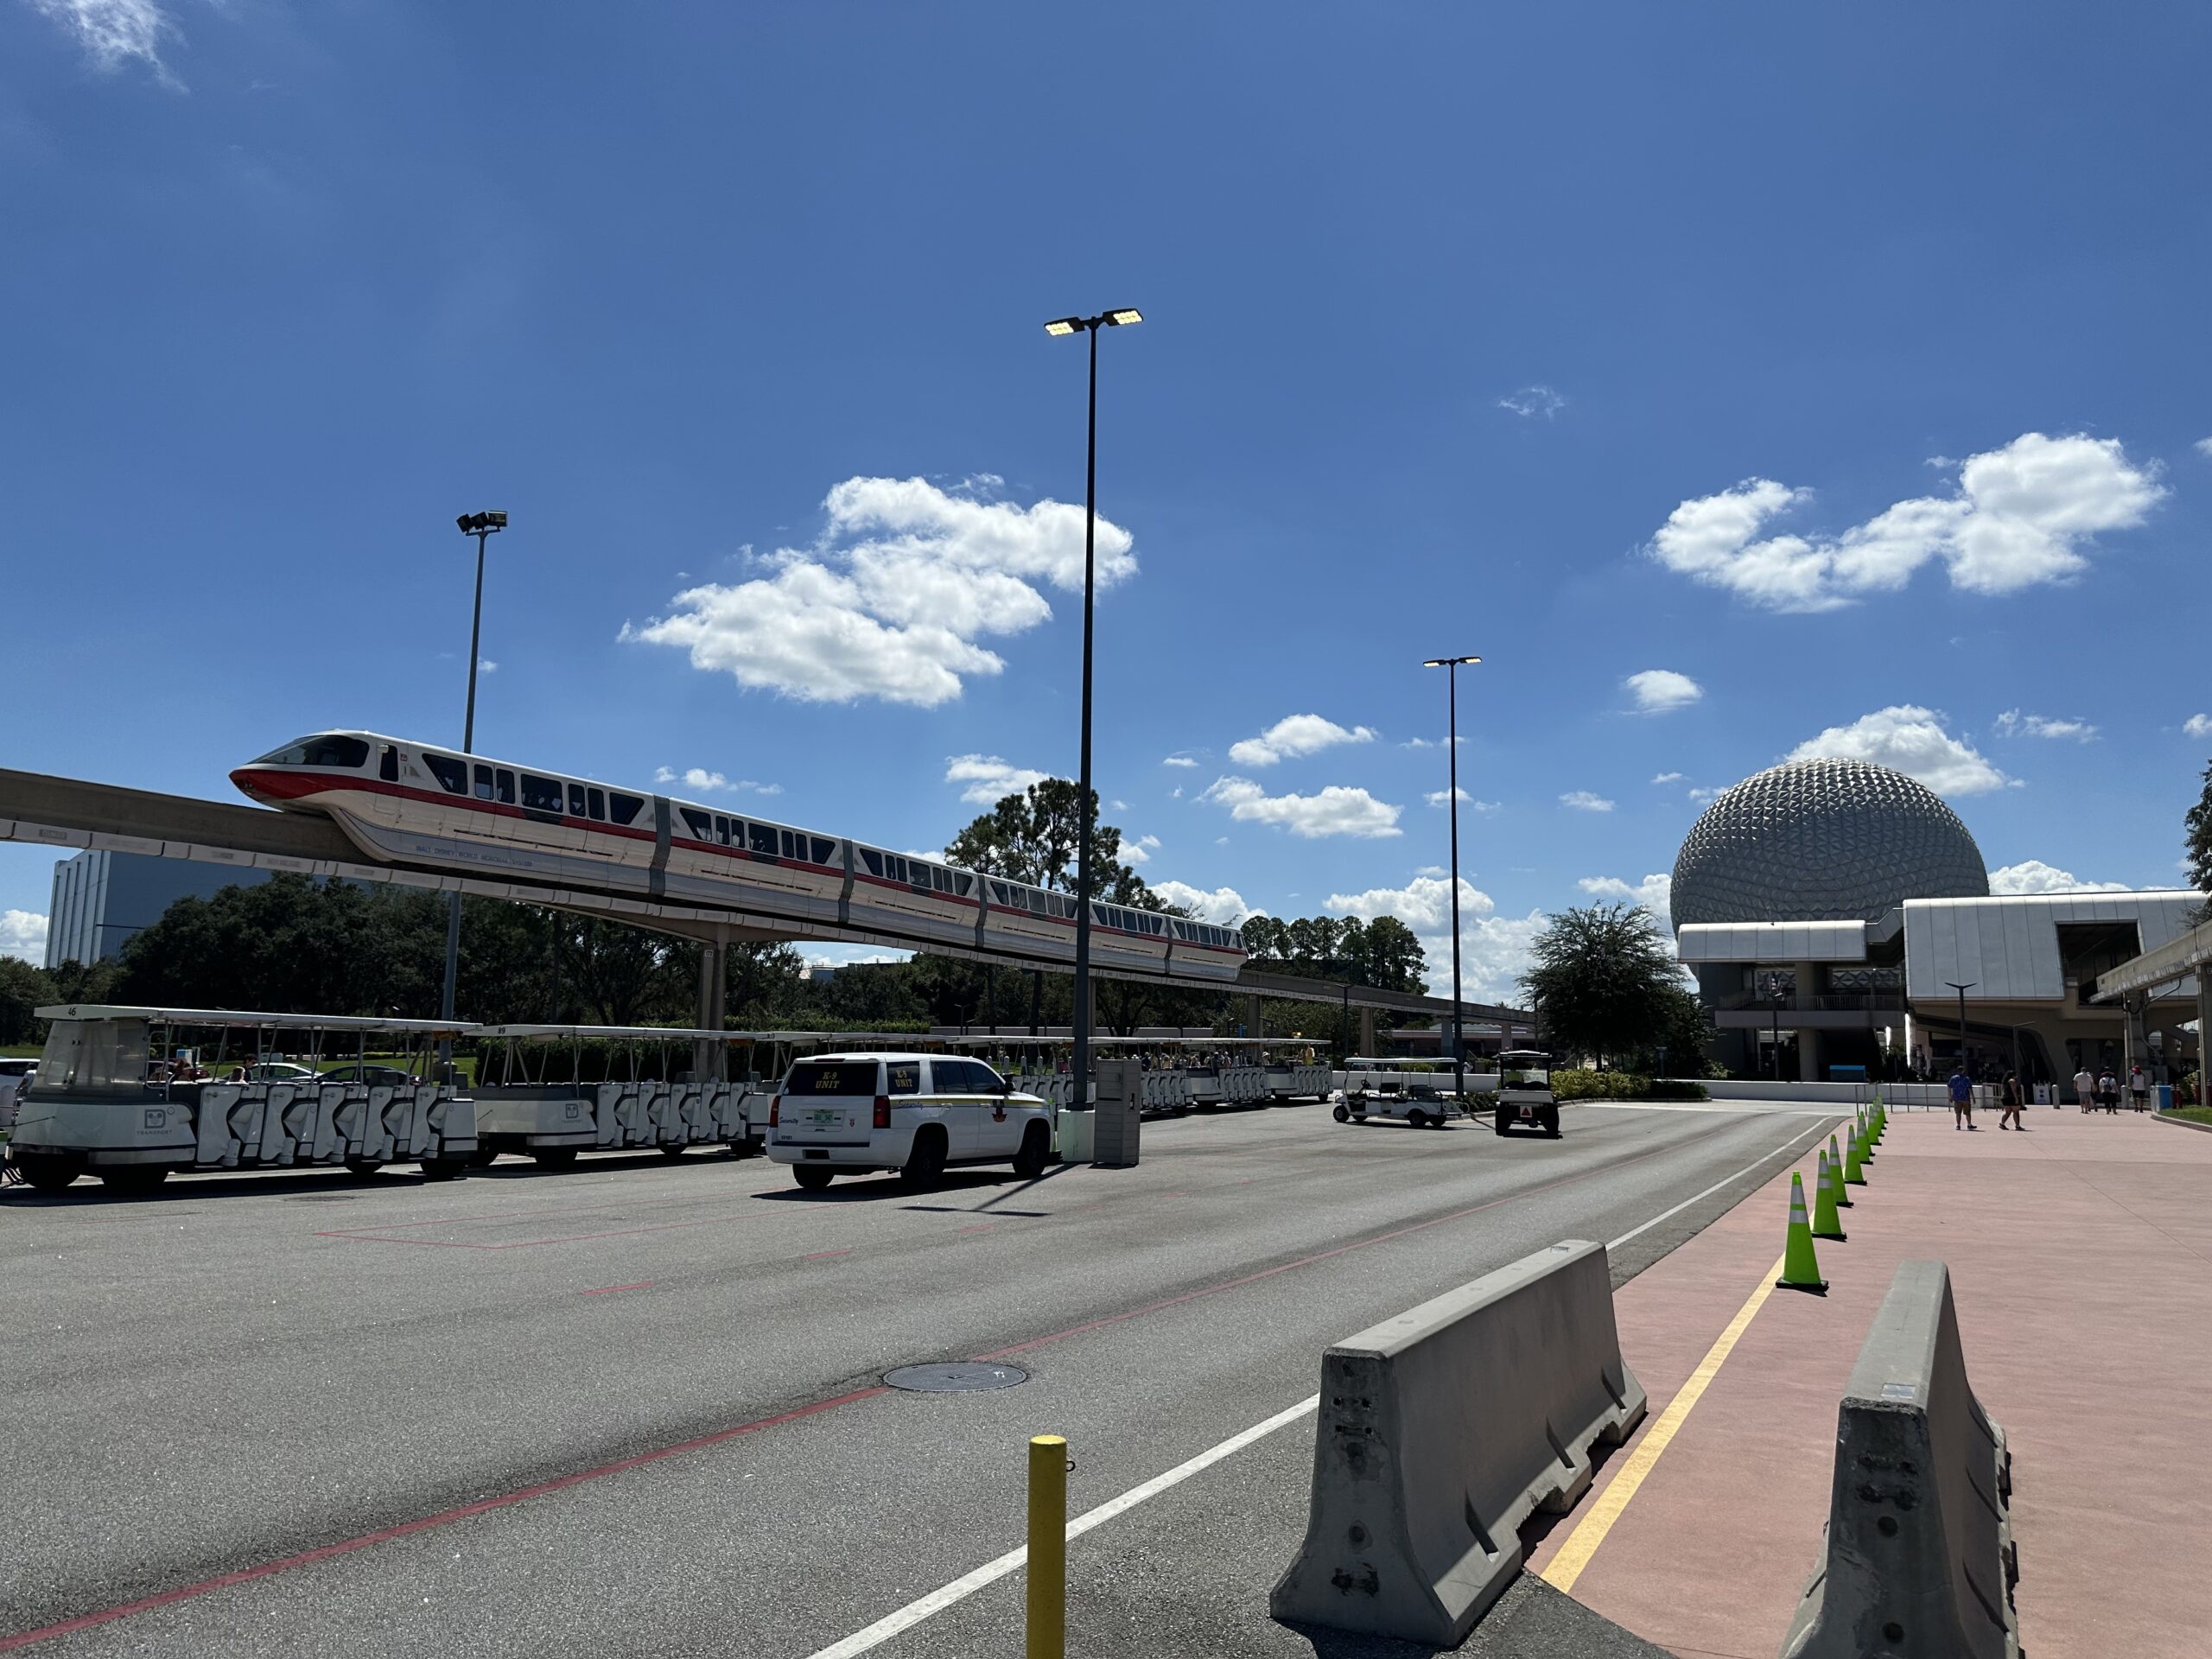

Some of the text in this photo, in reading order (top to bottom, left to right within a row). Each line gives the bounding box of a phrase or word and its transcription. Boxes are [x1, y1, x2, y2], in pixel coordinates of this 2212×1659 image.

[434, 848, 455, 856] DISNEY
[458, 851, 478, 860] WORLD
[67, 1007, 76, 1016] 46
[822, 1071, 837, 1080] K-9
[815, 1080, 840, 1089] UNIT
[895, 1078, 913, 1088] UNIT
[779, 1116, 798, 1125] Security
